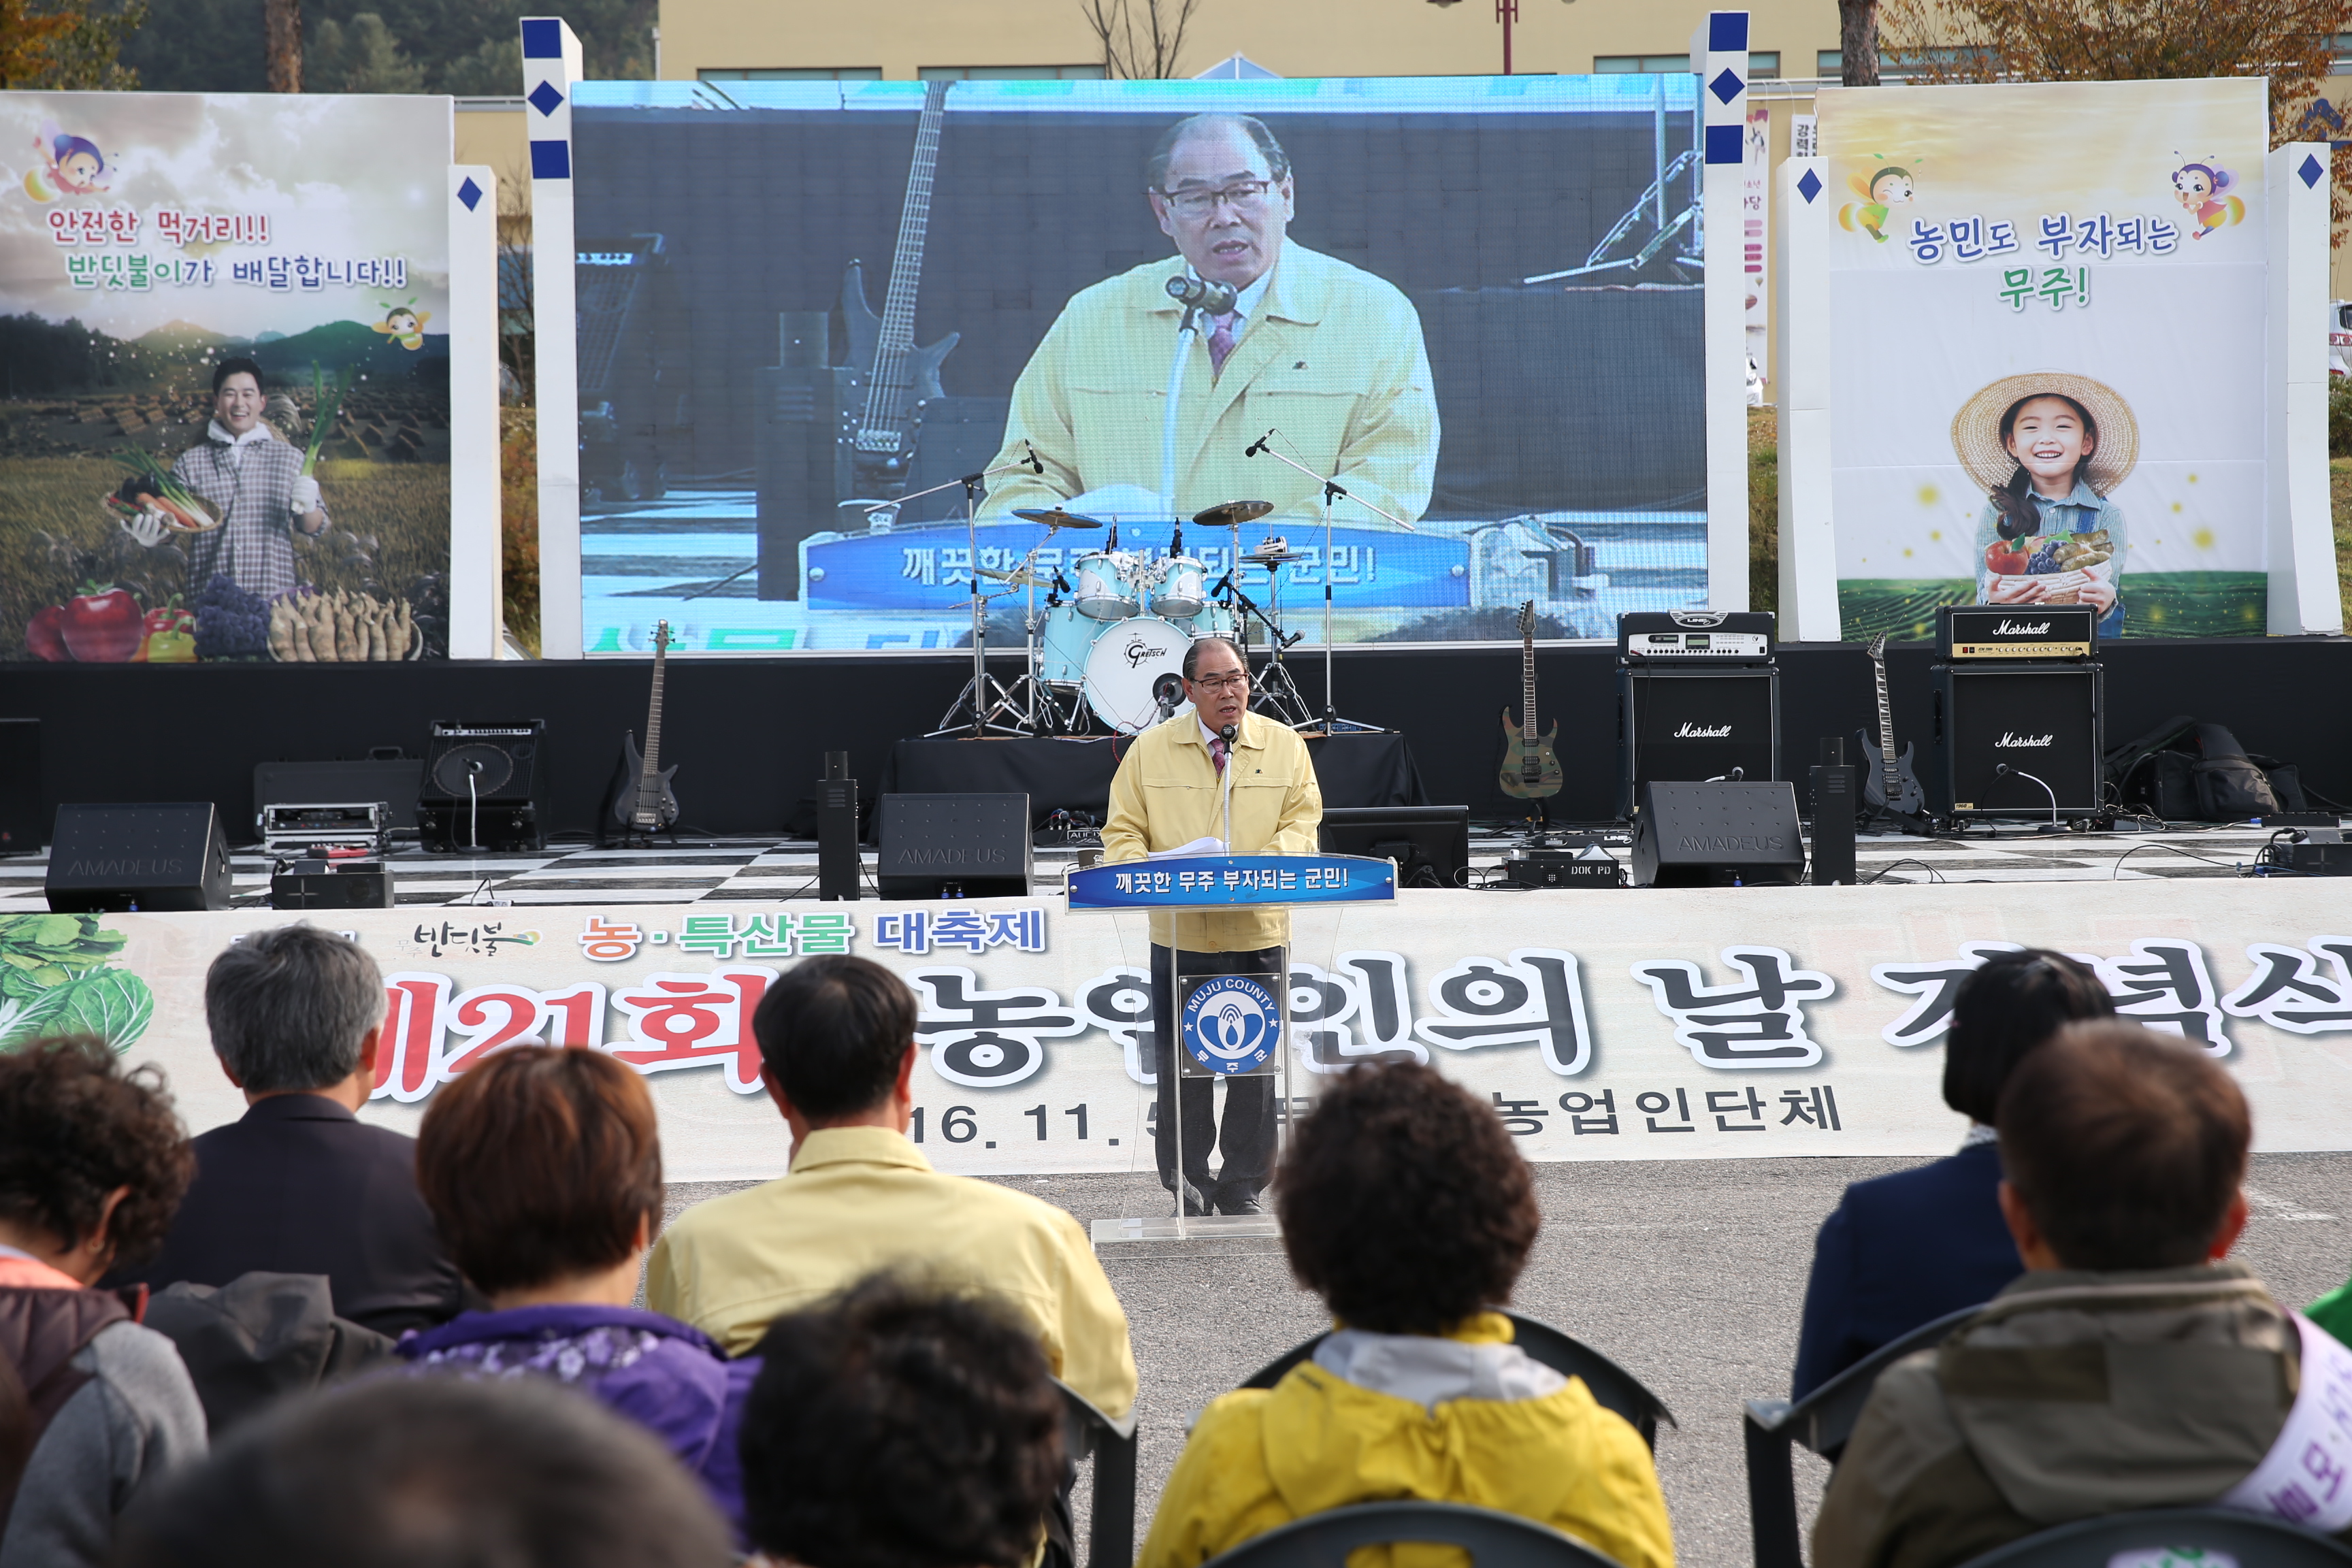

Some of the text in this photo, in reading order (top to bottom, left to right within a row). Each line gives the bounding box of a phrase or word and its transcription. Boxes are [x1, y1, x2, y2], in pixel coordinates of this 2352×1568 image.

[1744, 180, 1761, 189] 소년
[49, 211, 267, 244] 안전한 먹거리!!
[1910, 215, 2176, 260] 농민도 부자되는
[68, 255, 404, 287] 반딧불이가 배달합니다!!
[1999, 267, 2085, 308] 무주!
[1993, 619, 2051, 636] Marshall
[1128, 644, 1168, 668] GRETSCH
[1673, 721, 1731, 738] Marshall
[1995, 730, 2053, 748] Marshall
[898, 848, 1007, 864] AMADEUS
[1677, 836, 1784, 852] AMADEUS
[67, 859, 182, 877] AMADEUS
[1115, 867, 1349, 894] 깨끗한 무주 부자되는 군민!
[1571, 866, 1611, 875] DOK PD
[414, 920, 507, 958] 반딧불
[878, 910, 1045, 951] 대축제
[1187, 978, 1275, 1013] MUJU COUNTY
[1643, 954, 1821, 1059] 날
[1196, 1048, 1268, 1073] 무주군
[1492, 1085, 1842, 1137] 농업인단체
